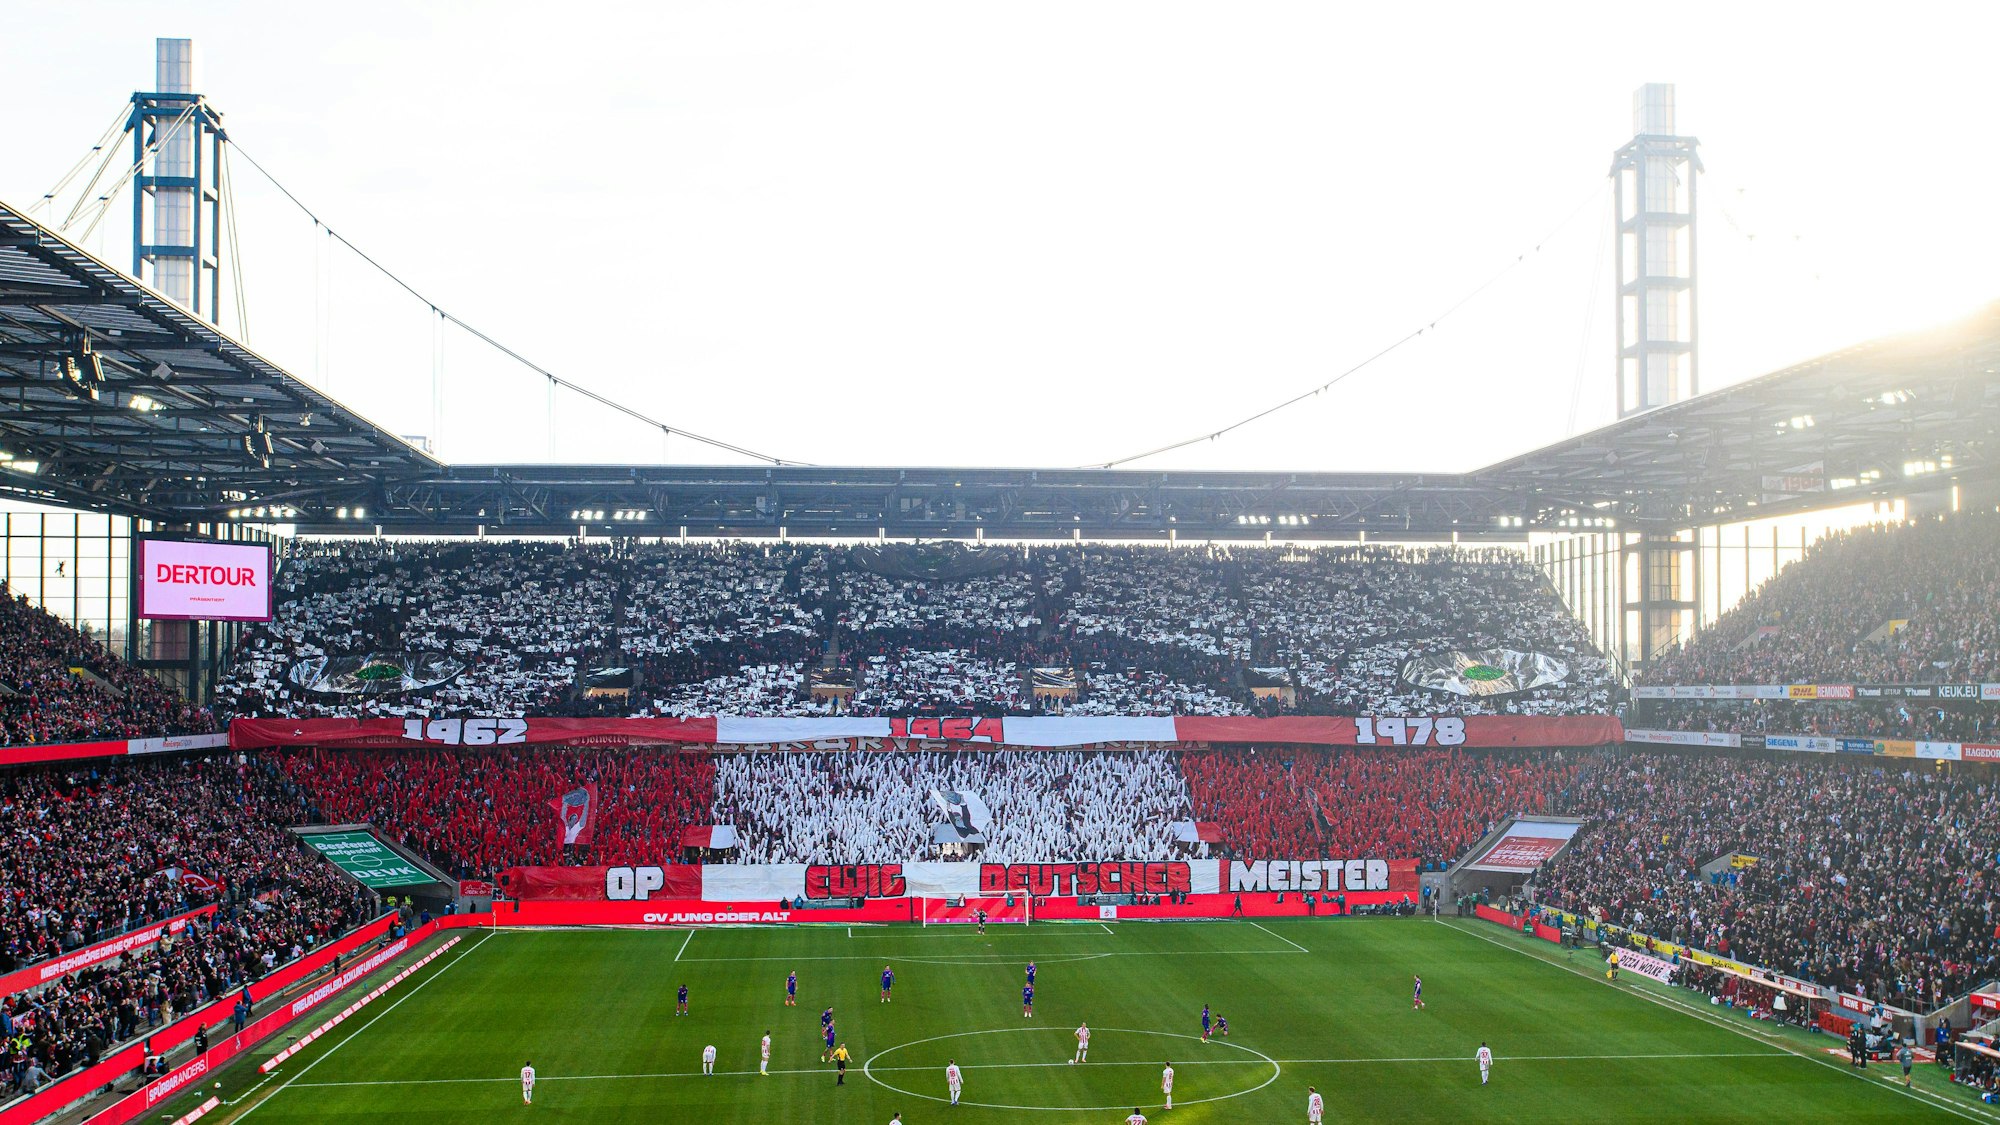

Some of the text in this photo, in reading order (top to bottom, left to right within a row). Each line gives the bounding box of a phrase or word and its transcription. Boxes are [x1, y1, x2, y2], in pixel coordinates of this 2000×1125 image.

[157, 563, 256, 587] DERTOUR
[1793, 687, 1813, 696] DHL
[1817, 686, 1851, 697] REMONDIS
[1938, 685, 1978, 698] KEUK.EU
[401, 717, 528, 745] 1962
[889, 717, 1004, 742] 1964
[1354, 717, 1467, 746] 1978
[1766, 736, 1798, 747] SIEGENIA
[314, 841, 377, 851] Bestens
[325, 846, 383, 857] aufgestellt
[350, 866, 418, 879] DEVK
[605, 859, 1391, 900] OP EWIG DEUTSCHER MEISTER
[643, 912, 791, 922] OV JUNG ODER ALT
[41, 963, 59, 980] MER
[59, 949, 101, 973] SCHWÖRE
[100, 944, 114, 958] DIR
[112, 941, 124, 953] HE
[123, 937, 134, 949] OP
[133, 932, 151, 947] TREU
[1620, 955, 1664, 978] PIZZA WOLKE
[292, 994, 314, 1016] FREUD
[313, 986, 331, 1004] ODER
[1842, 997, 1859, 1010] REWE
[1983, 999, 1997, 1009] REWE
[148, 1059, 207, 1103] SPÜRBAR ANDERS.
